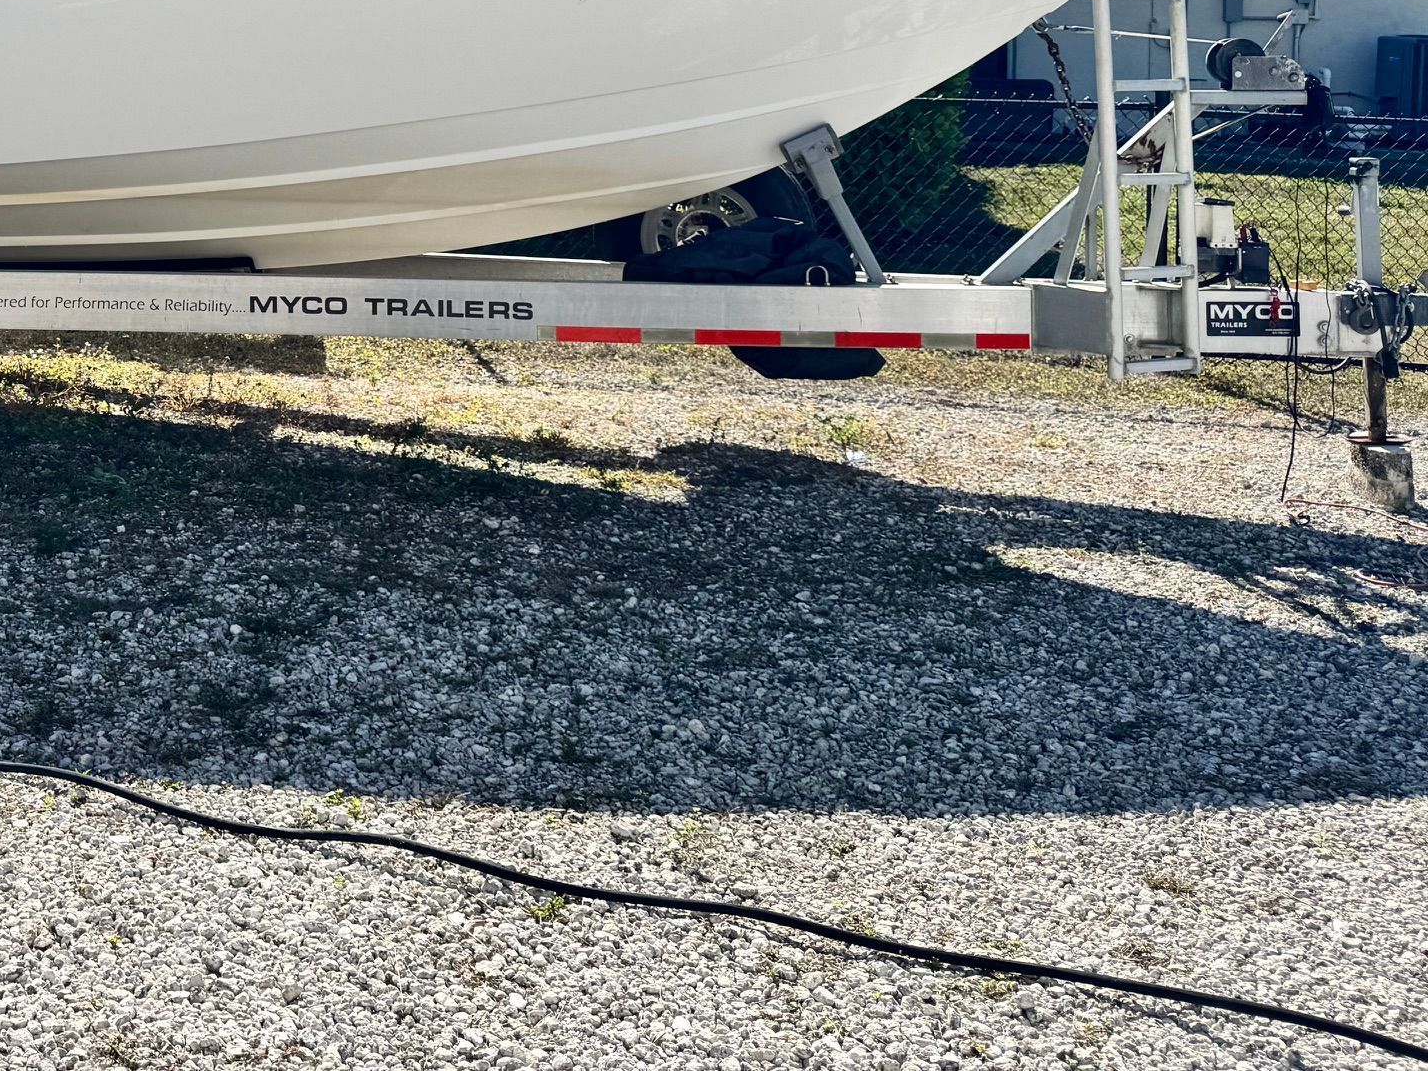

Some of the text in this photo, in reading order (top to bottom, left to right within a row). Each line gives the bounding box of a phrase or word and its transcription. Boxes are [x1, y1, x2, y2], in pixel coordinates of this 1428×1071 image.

[31, 295, 51, 309] for
[54, 296, 145, 311] Performance
[149, 298, 160, 311] &
[249, 295, 348, 315] MYCO
[364, 297, 534, 321] TRAILERS
[1210, 304, 1294, 320] MYCO
